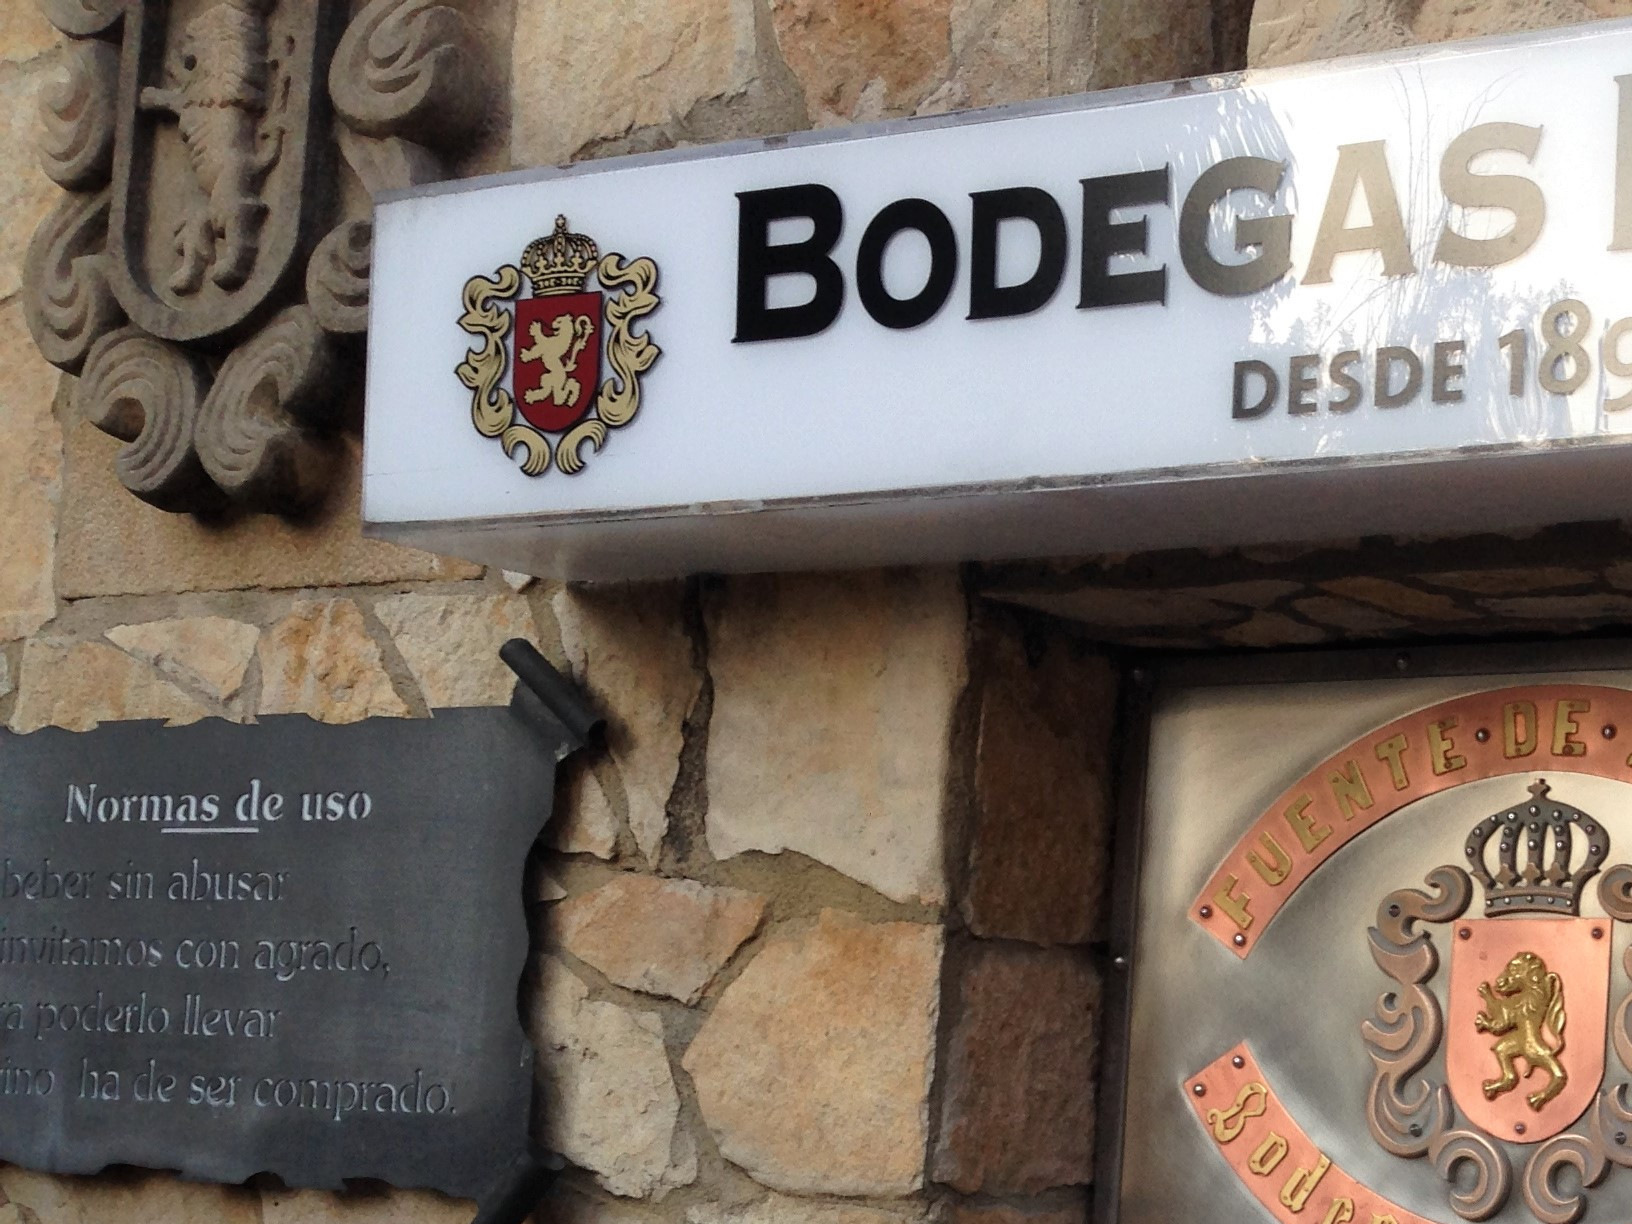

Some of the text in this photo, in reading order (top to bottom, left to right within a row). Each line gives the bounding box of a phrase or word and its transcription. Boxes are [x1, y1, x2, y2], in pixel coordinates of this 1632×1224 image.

[731, 121, 1544, 344] BODEGAS
[1231, 339, 1466, 421] DESDE
[64, 779, 372, 824] Normas de uso
[1211, 716, 1466, 932] FUENTE
[1503, 700, 1591, 759] DE
[1, 857, 291, 901] beber sin abusar
[0, 926, 391, 982] invitamos con agrado,
[36, 991, 170, 1041] poderlo
[182, 994, 283, 1039] llevar
[0, 1057, 457, 1121] ino ha de ser comprado.
